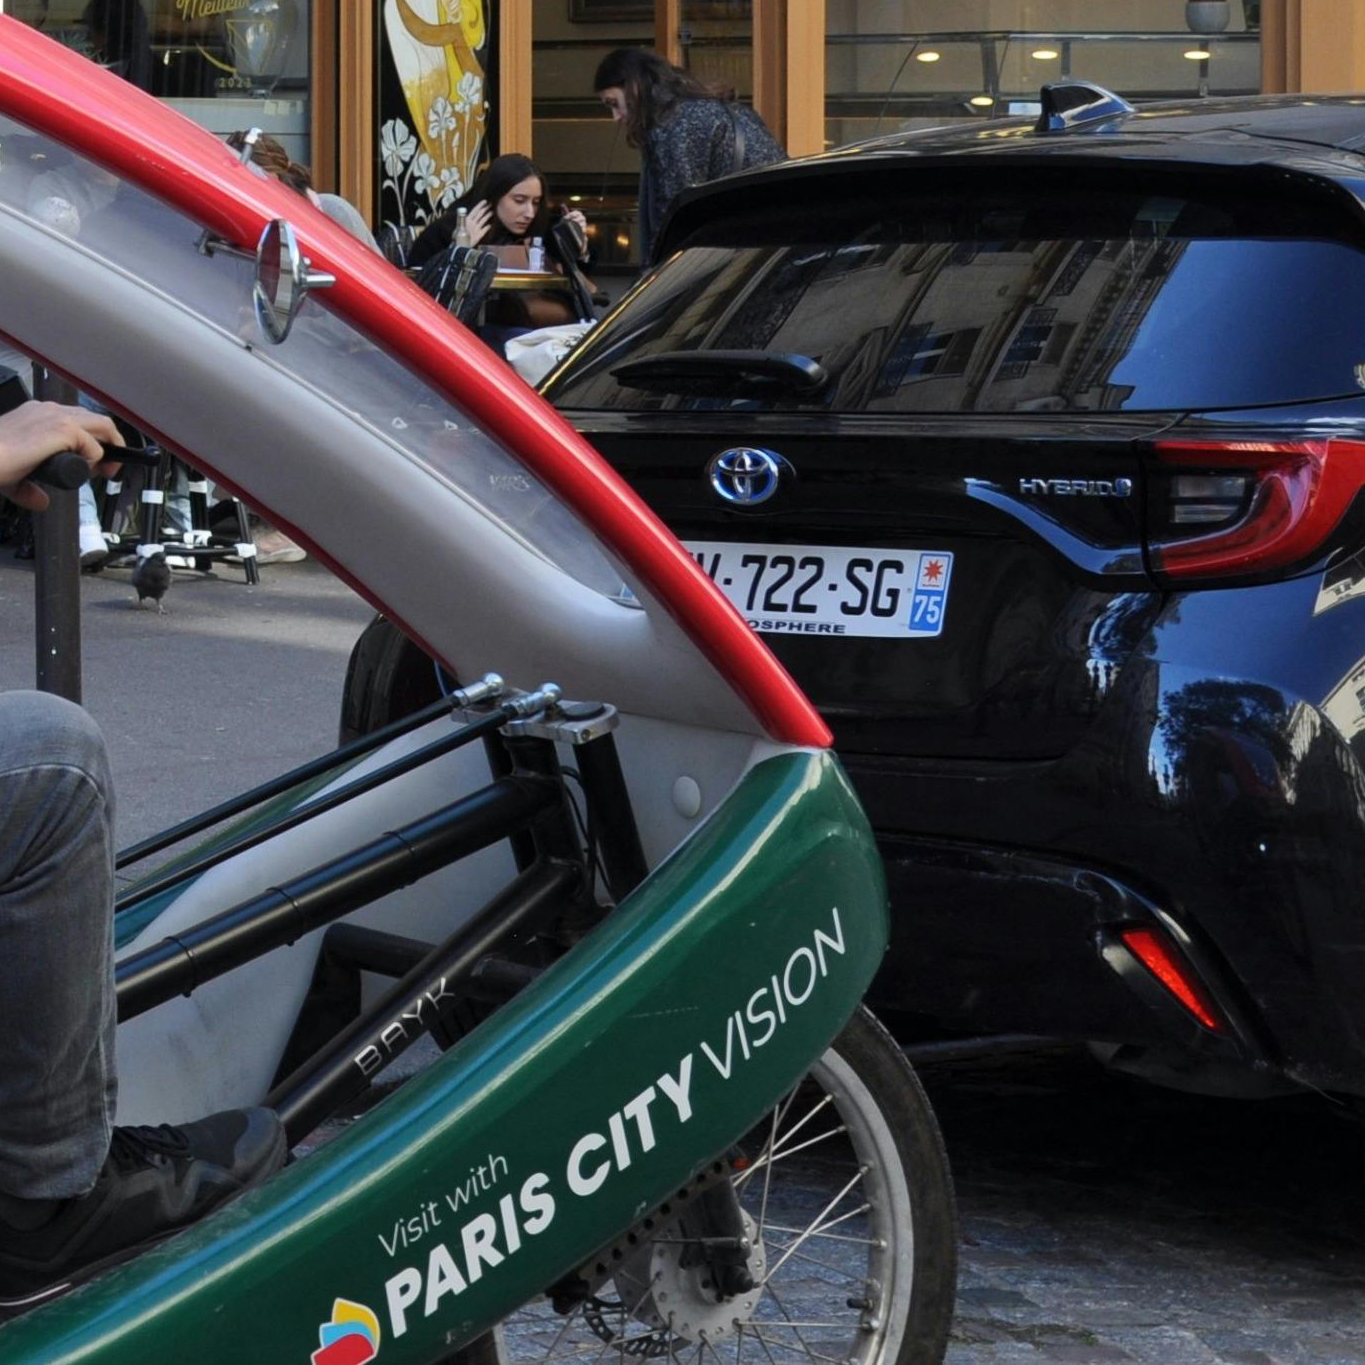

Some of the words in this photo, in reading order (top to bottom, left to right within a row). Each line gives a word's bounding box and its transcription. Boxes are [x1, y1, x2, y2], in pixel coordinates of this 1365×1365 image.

[1019, 478, 1113, 496] HYBRID
[748, 619, 847, 634] OSPHERE
[914, 595, 942, 624] 75
[353, 975, 456, 1076] BAYK
[383, 1171, 556, 1338] PARIS
[566, 1053, 694, 1198] CITY
[699, 907, 848, 1081] VISION
[377, 1206, 443, 1259] Visit
[443, 1151, 511, 1216] with
